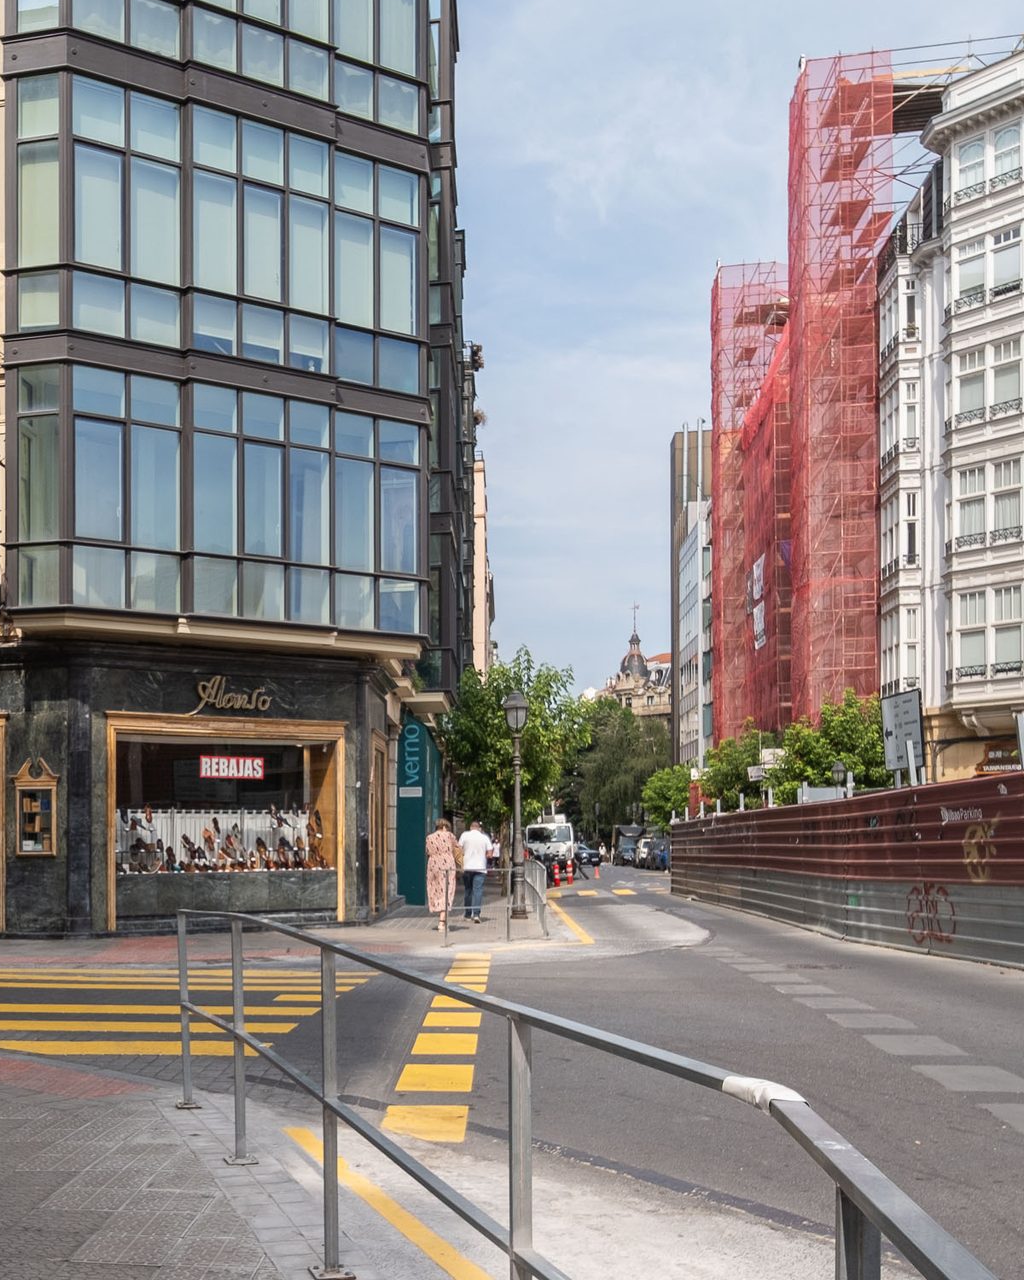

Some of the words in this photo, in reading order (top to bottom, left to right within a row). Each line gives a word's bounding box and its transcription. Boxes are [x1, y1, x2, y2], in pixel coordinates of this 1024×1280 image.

[186, 675, 273, 717] Alonso
[201, 757, 263, 778] REBAJAS
[404, 724, 420, 785] verno
